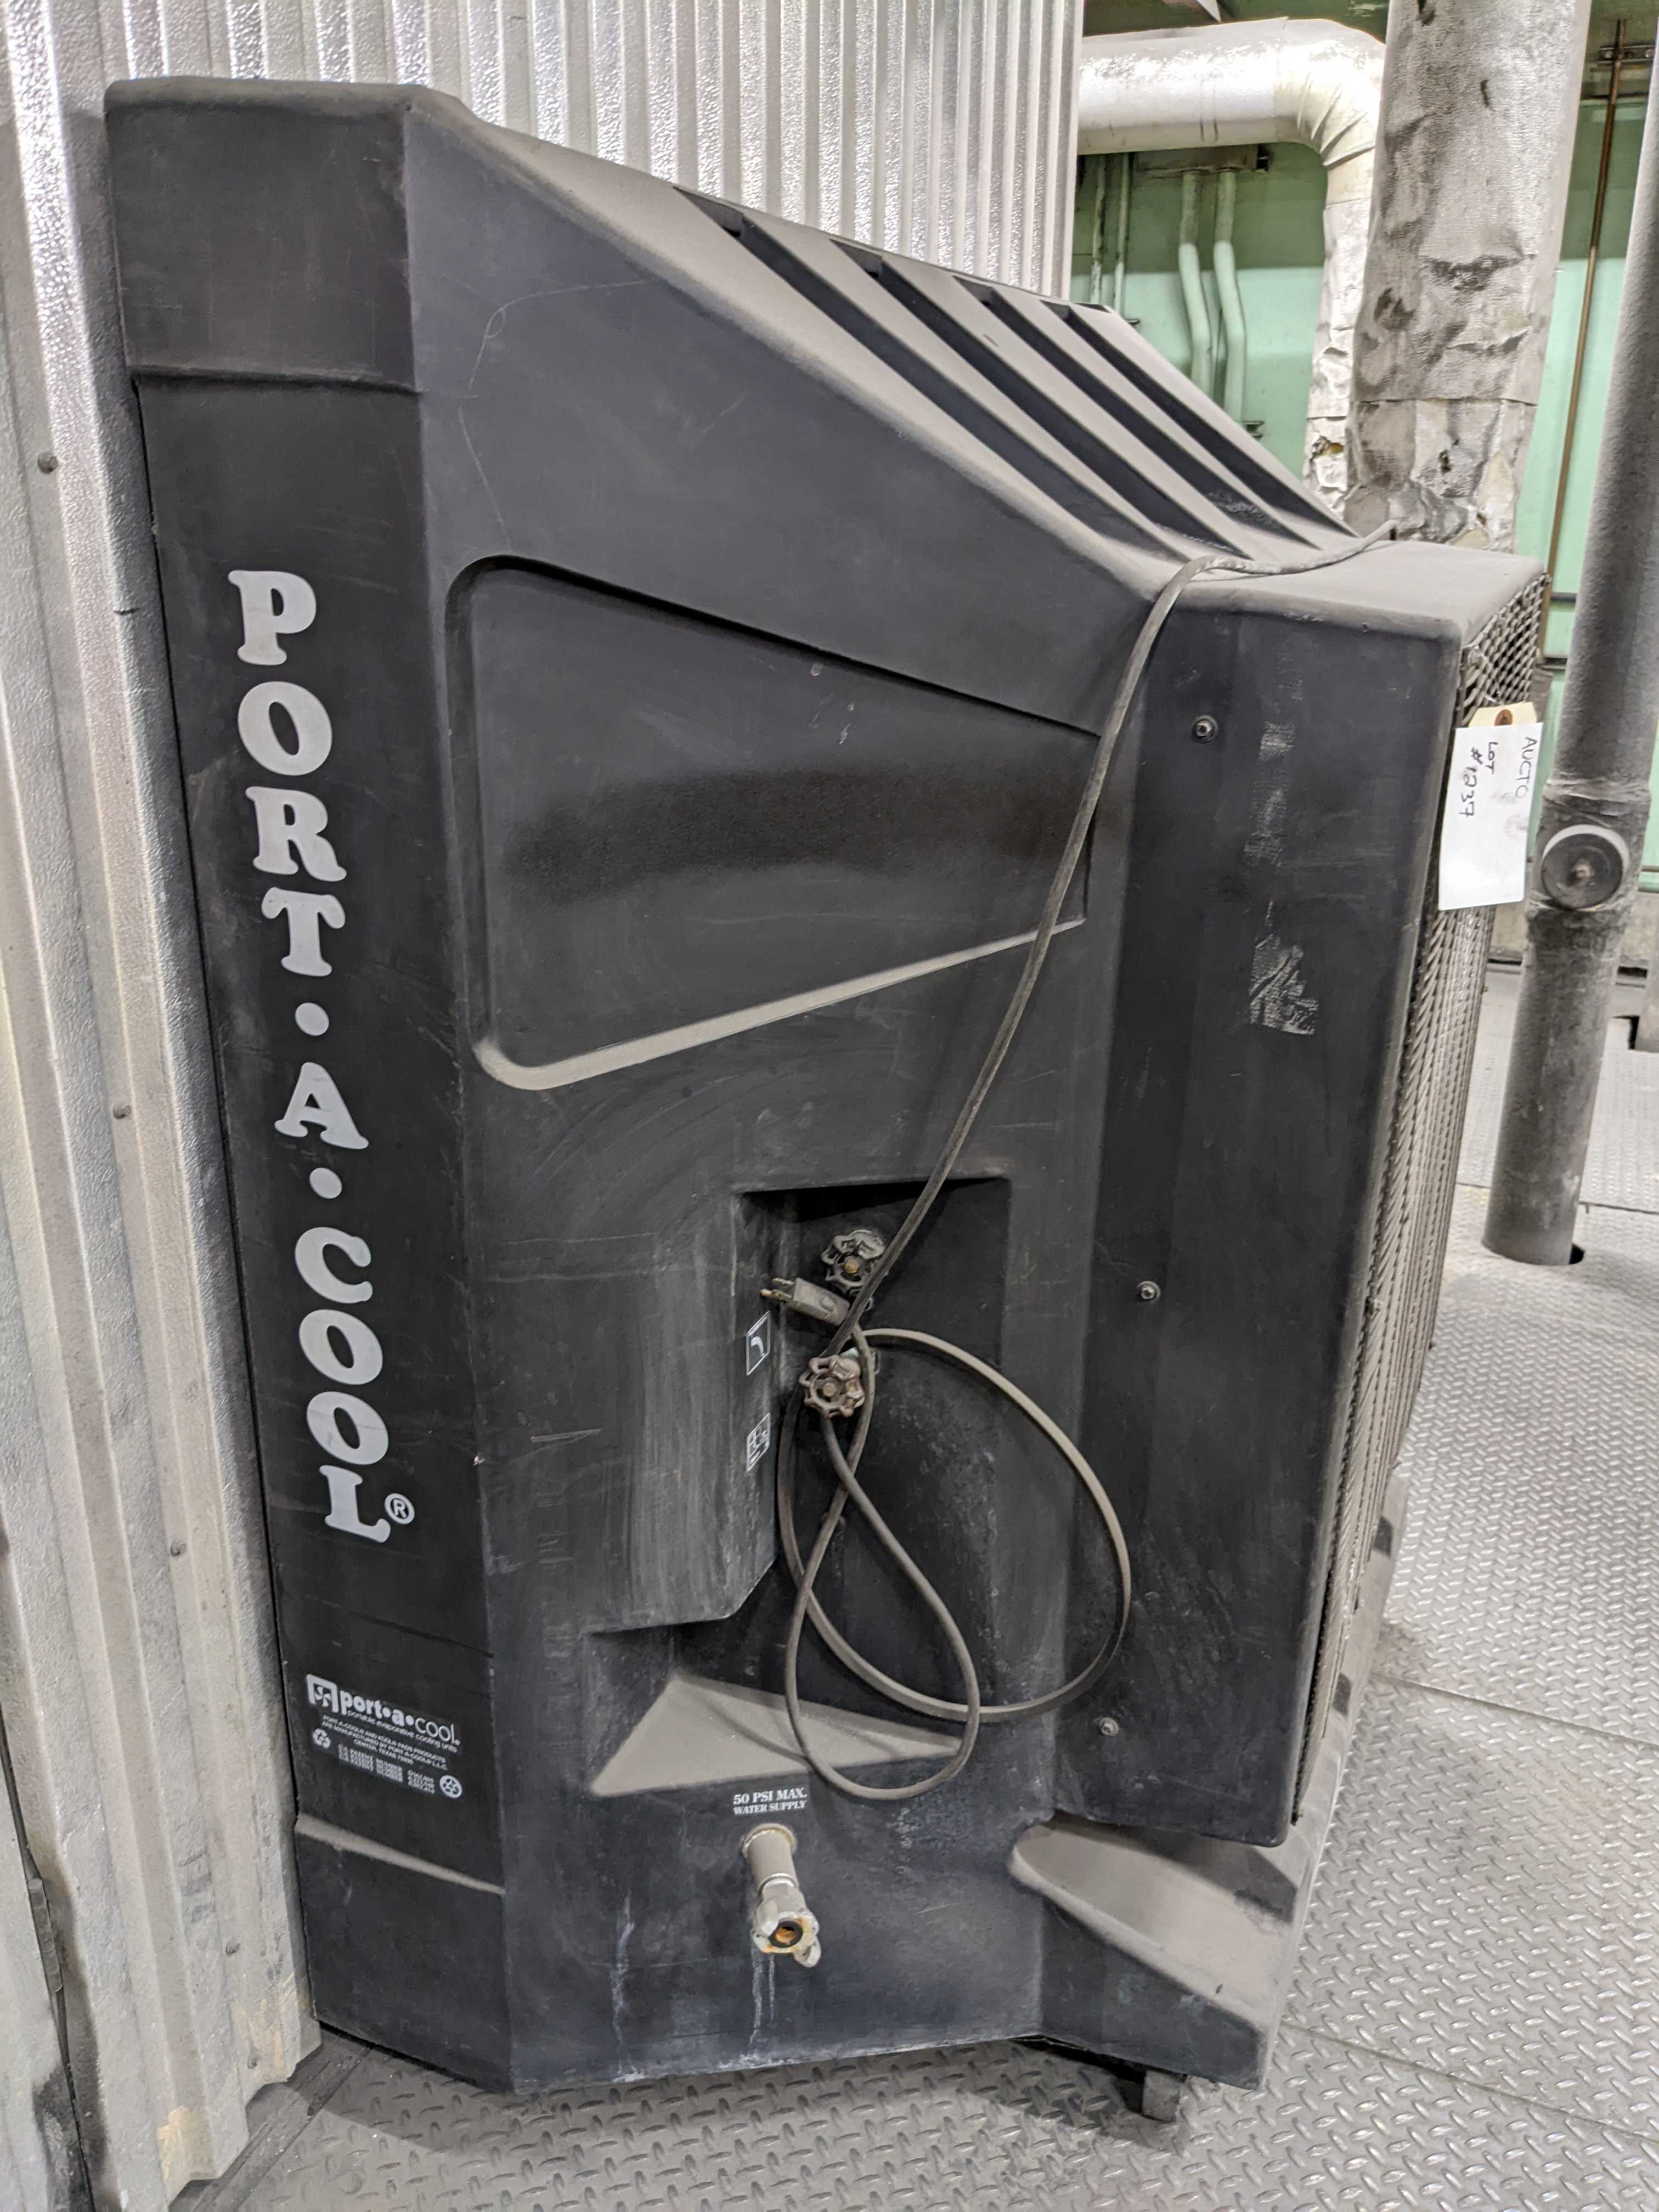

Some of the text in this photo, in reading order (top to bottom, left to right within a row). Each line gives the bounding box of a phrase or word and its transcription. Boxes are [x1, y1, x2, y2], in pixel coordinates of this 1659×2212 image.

[1485, 742, 1498, 775] LOT
[733, 1787, 808, 1804] 50 PSI MAX.
[733, 1800, 806, 1815] WATER SUPPLY
